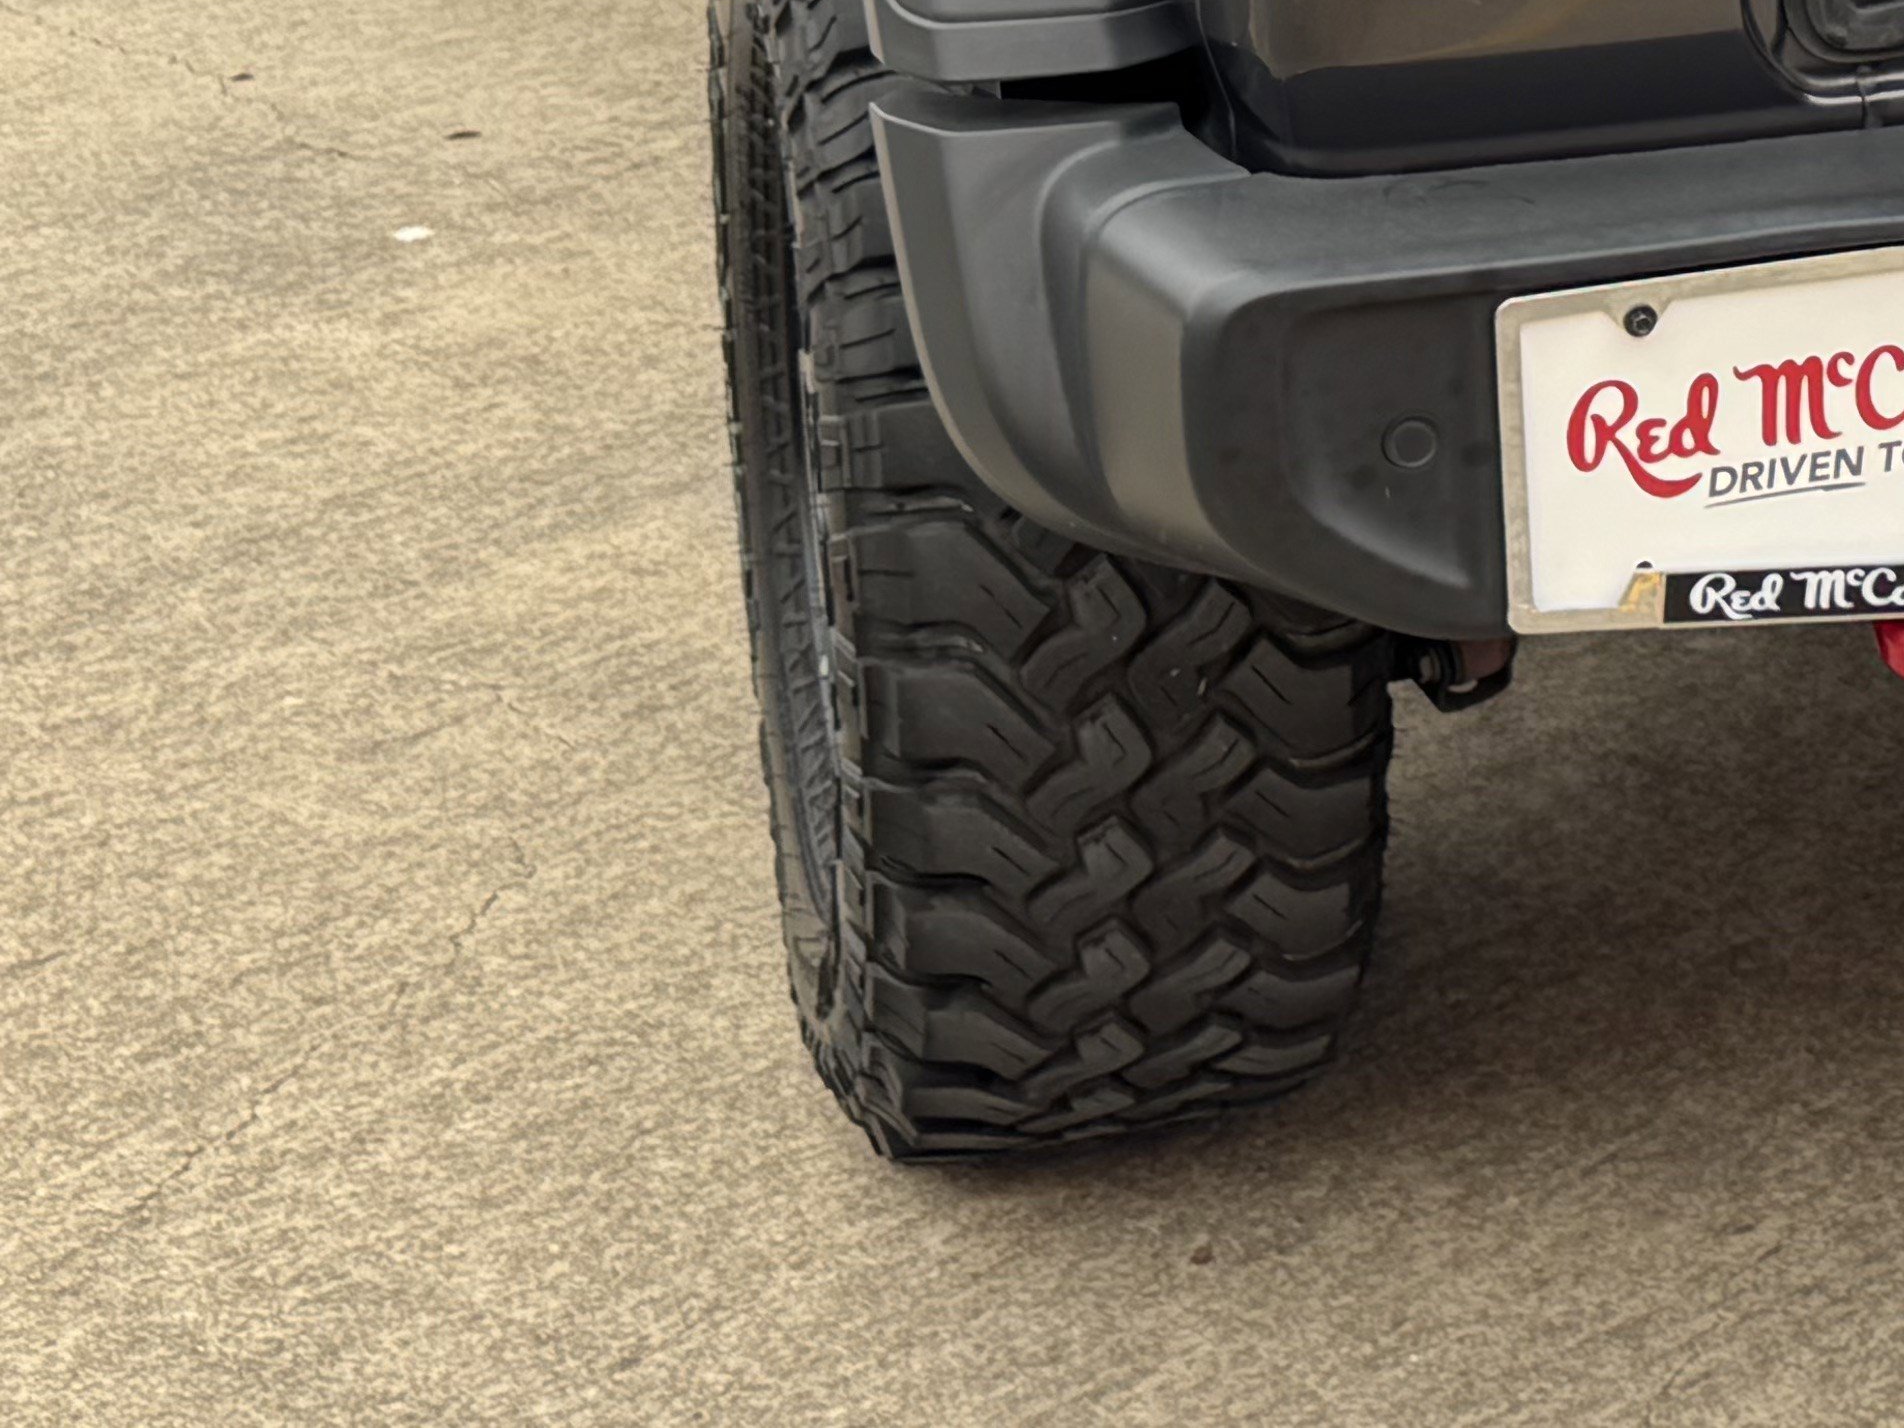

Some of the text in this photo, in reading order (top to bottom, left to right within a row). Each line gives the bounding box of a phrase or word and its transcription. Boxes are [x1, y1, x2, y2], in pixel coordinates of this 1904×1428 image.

[1566, 372, 1720, 498] Red
[1708, 446, 1866, 499] DRIVEN
[1689, 572, 1784, 621] Red
